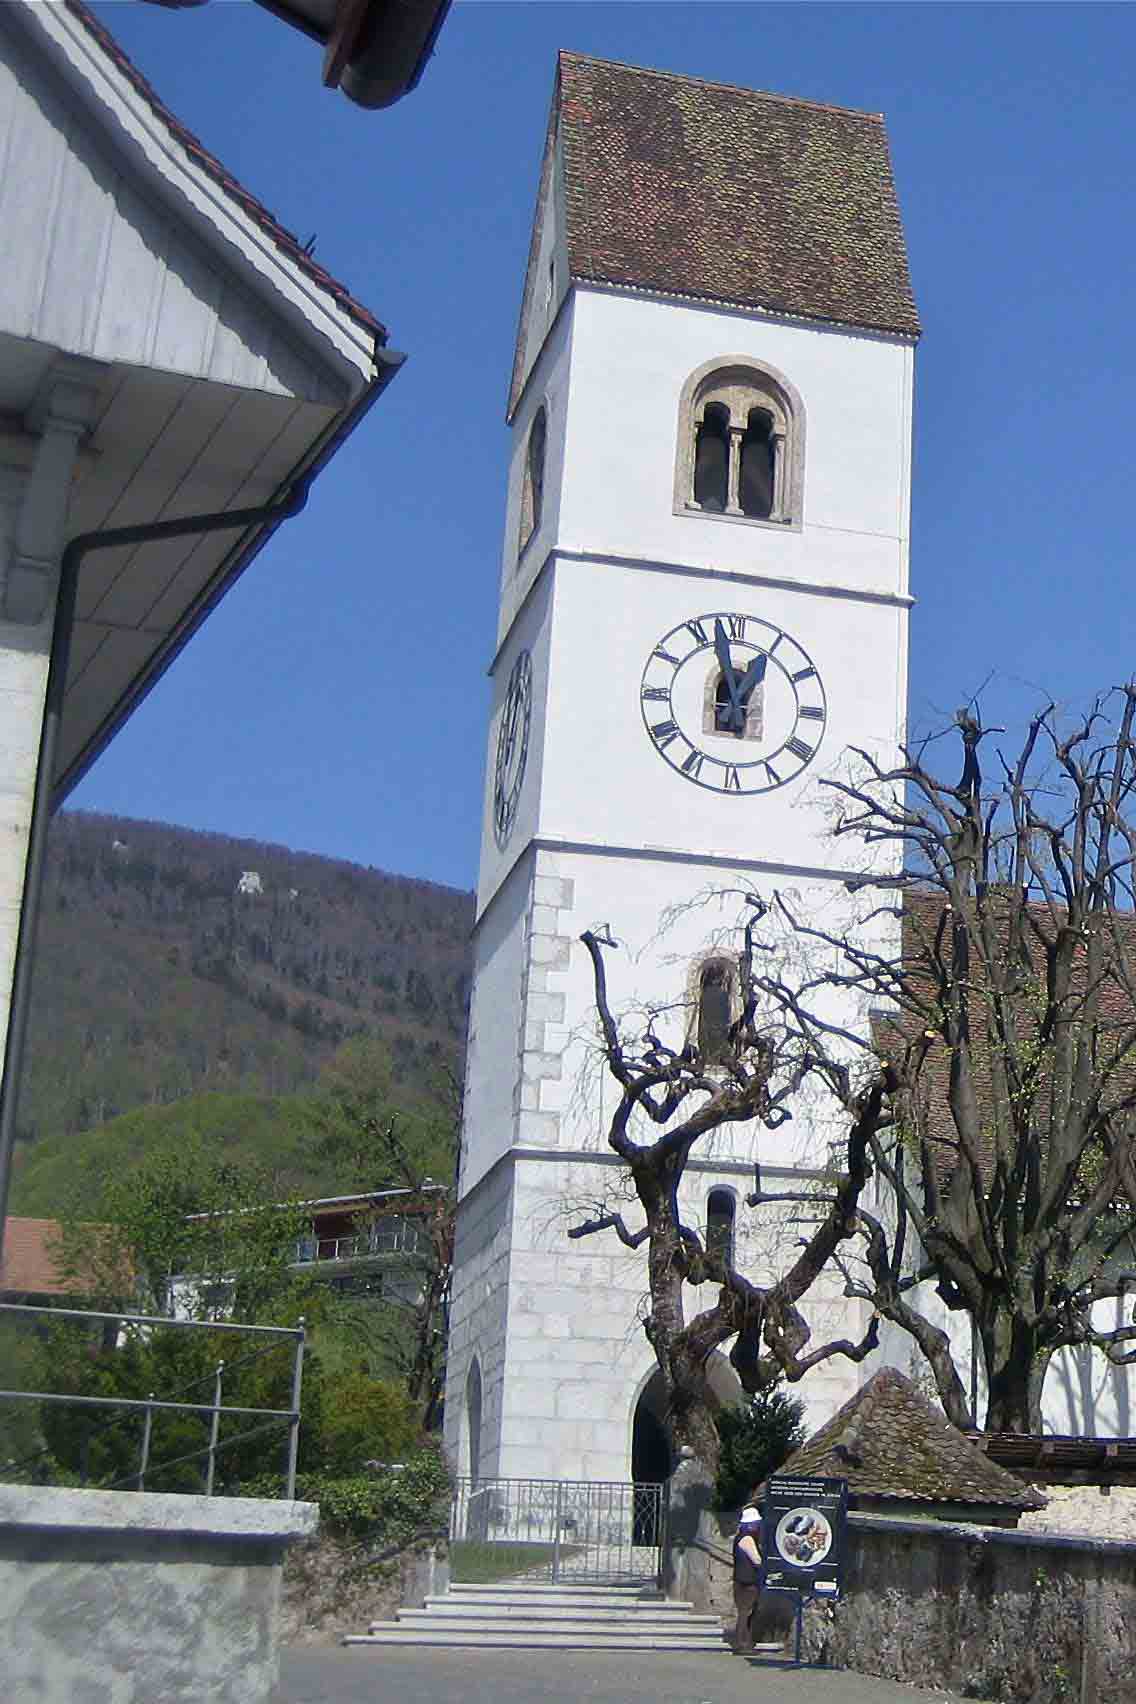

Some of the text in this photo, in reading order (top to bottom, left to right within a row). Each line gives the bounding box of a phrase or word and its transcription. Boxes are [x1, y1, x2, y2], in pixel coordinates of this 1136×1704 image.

[728, 616, 746, 640] XII
[724, 766, 741, 790] VI
[763, 760, 781, 784] V
